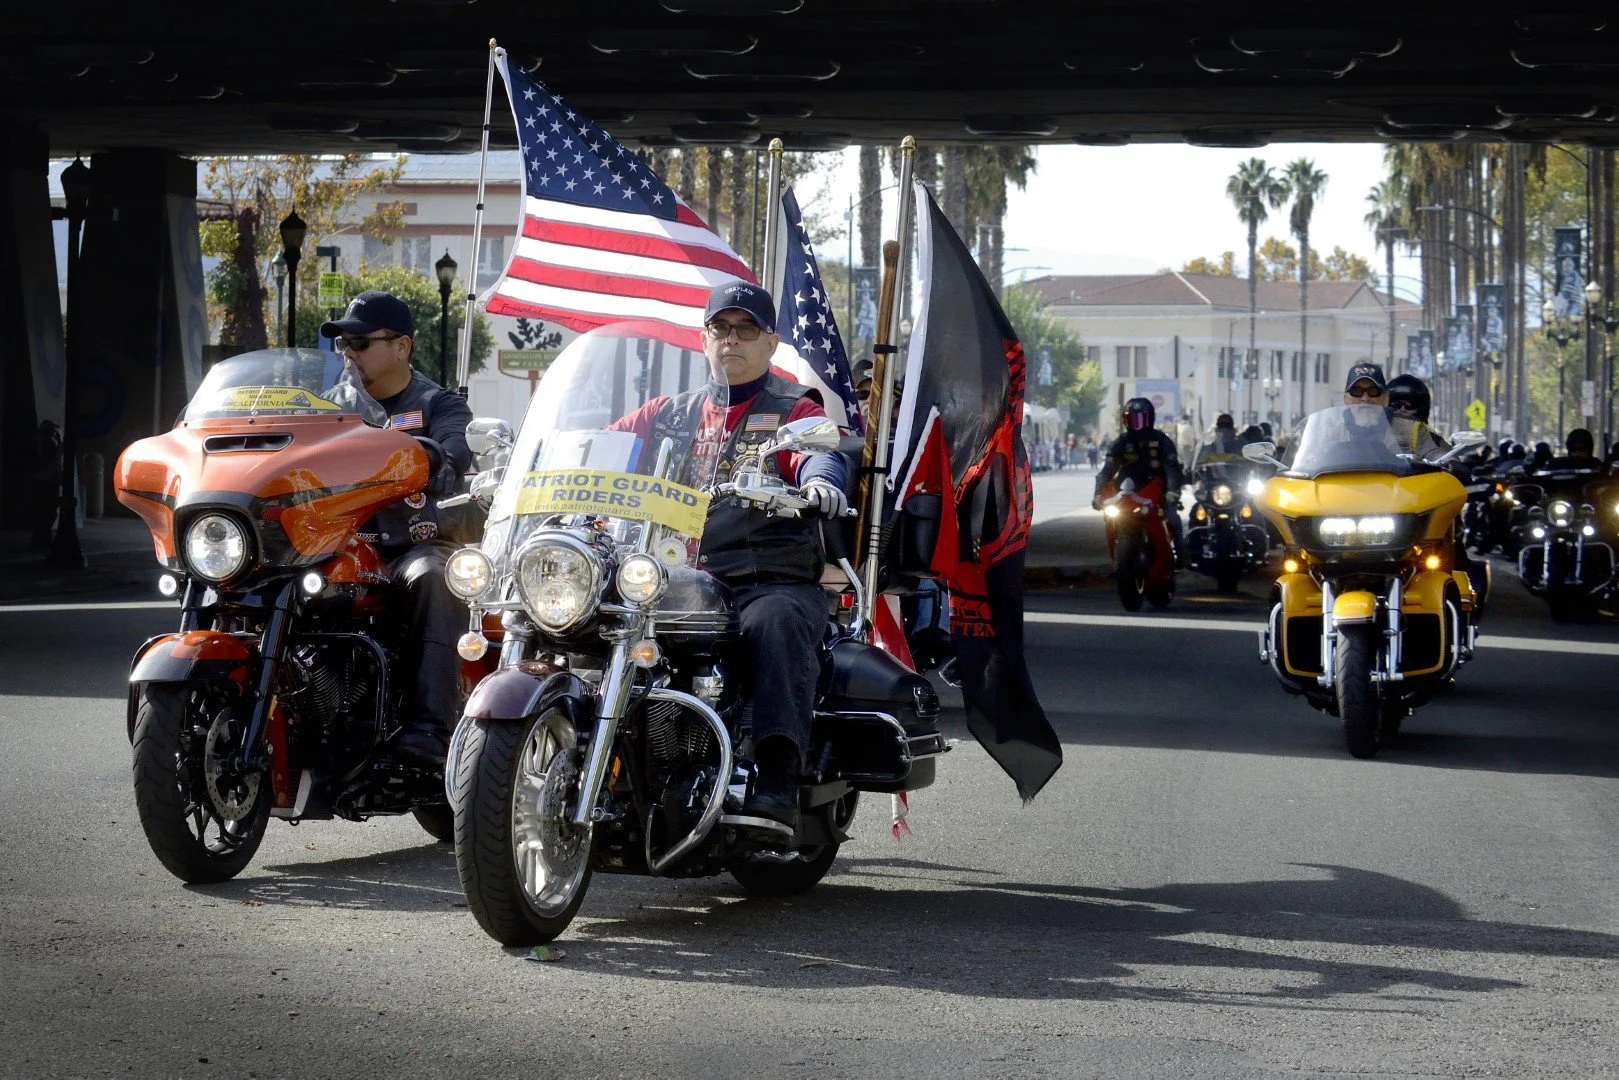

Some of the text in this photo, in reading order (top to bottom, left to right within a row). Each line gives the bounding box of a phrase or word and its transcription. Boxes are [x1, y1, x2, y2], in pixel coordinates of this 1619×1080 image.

[578, 438, 594, 467] 1
[521, 473, 698, 507] ATRIOT GUARD
[551, 488, 642, 508] RIDERS
[534, 502, 654, 520] www.patriotguard.org
